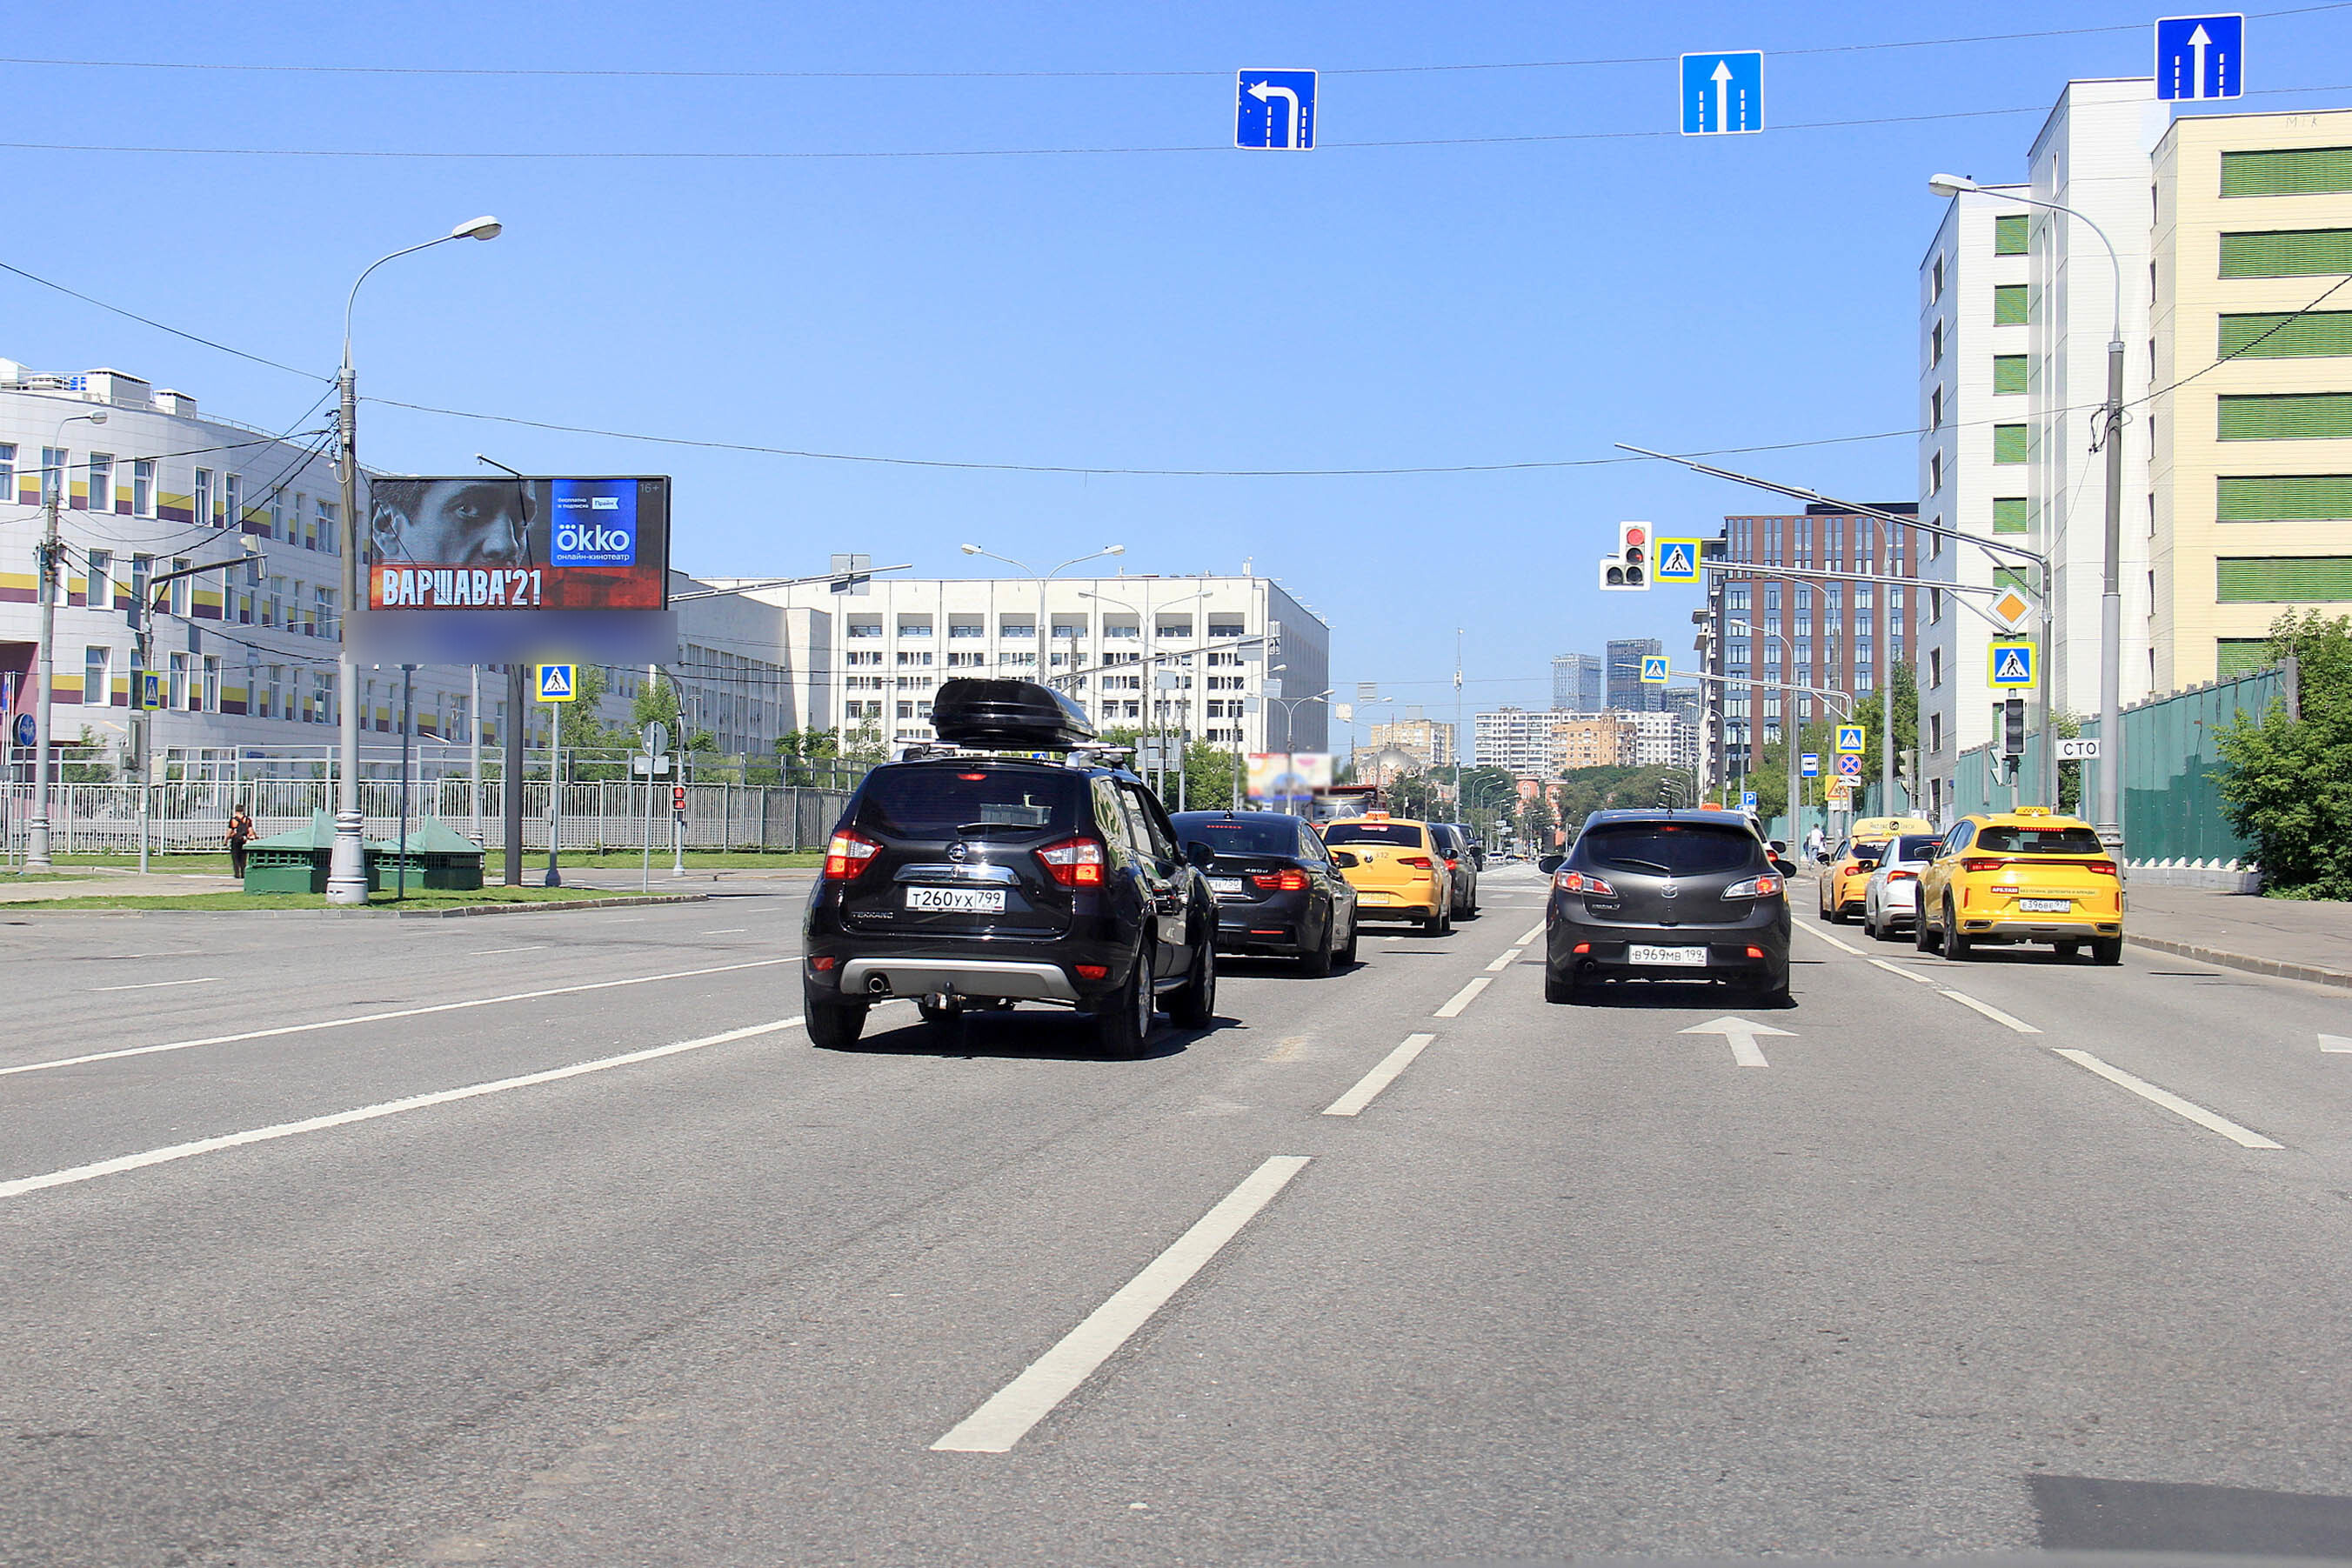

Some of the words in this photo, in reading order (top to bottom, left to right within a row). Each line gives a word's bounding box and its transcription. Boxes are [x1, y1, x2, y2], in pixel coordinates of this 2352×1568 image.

[640, 483, 659, 493] 16+
[557, 552, 631, 562] онлайн-кинотеатр
[382, 569, 542, 606] ВАРШАВА'21
[2063, 742, 2101, 756] СТО
[912, 891, 973, 907] Т260УХ
[978, 891, 1000, 904] 799
[1635, 948, 1681, 961] В969МВ
[1685, 949, 1702, 957] 199
